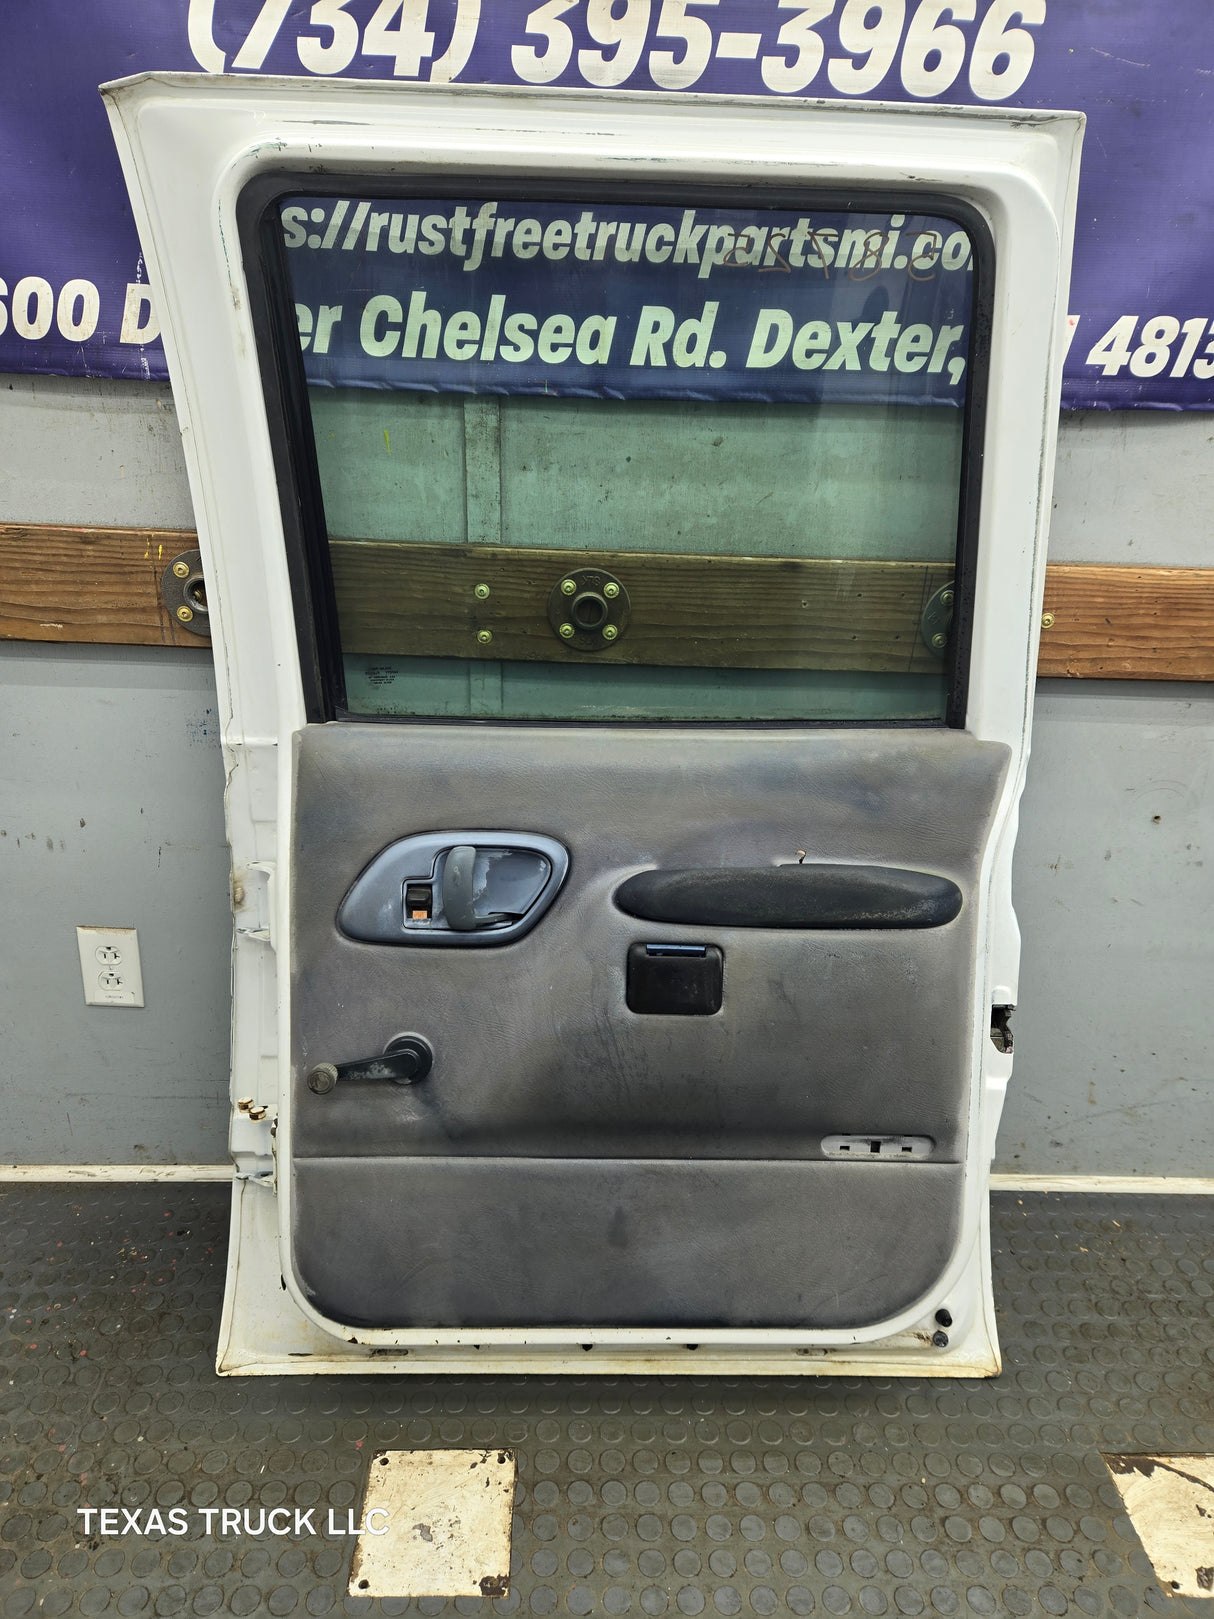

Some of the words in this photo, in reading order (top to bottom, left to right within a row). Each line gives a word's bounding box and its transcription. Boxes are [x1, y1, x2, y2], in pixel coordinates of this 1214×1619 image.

[511, 0, 1047, 100] 395-3966
[281, 200, 974, 279] s://rustfreetruckpartsmi.co
[360, 290, 618, 365] Chelsea
[629, 301, 727, 369] Rd.
[745, 308, 967, 386] Dexter,
